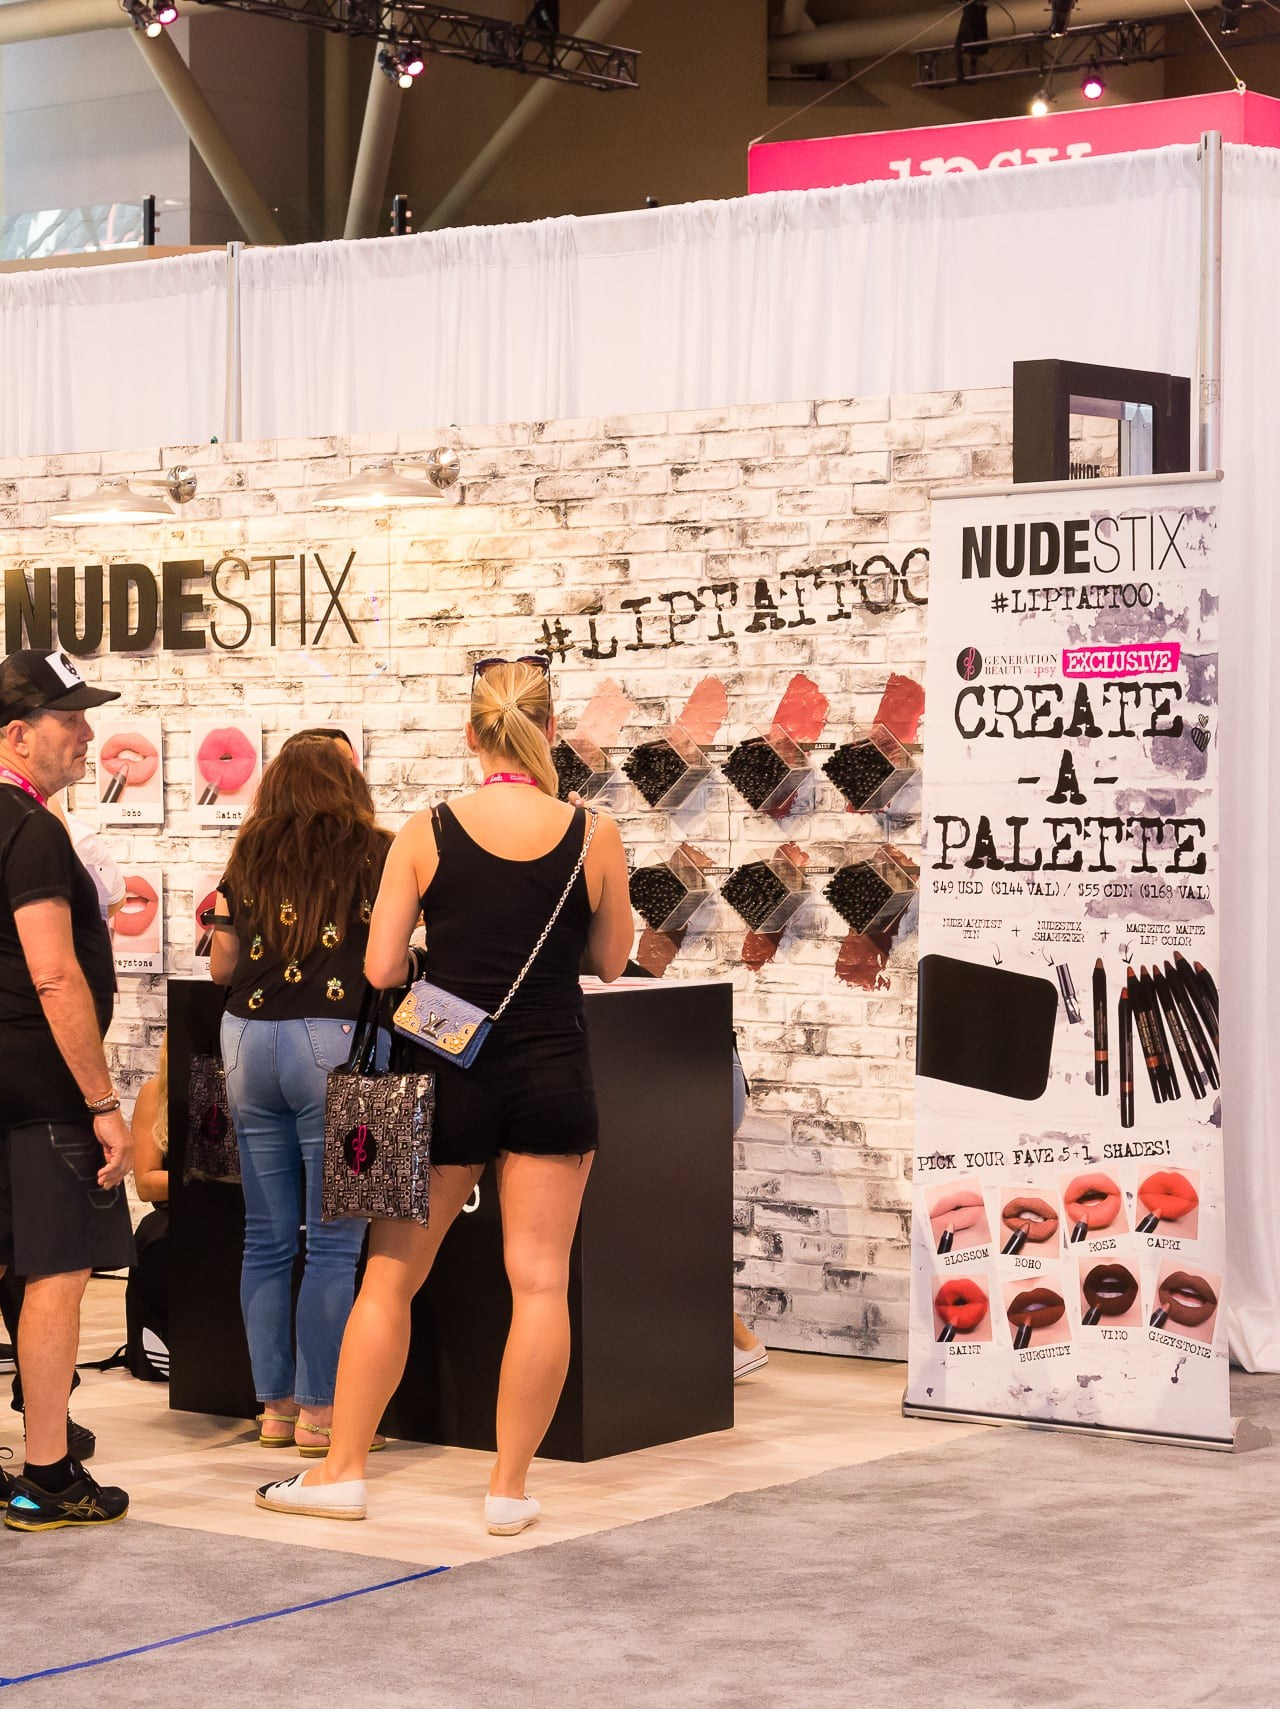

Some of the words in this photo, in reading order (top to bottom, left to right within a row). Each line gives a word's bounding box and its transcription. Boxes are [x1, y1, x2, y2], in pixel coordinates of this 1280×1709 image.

[961, 513, 1187, 580] NUDESTIX
[4, 551, 360, 656] NUDESTIX
[991, 583, 1153, 614] #LIPTATTOO
[984, 654, 1057, 665] GENERATION
[1066, 650, 1172, 673] EXCLUSIVE
[985, 666, 1023, 675] BEAUTY
[1033, 666, 1057, 677] ipsy
[954, 681, 1184, 739] CREATE
[122, 809, 142, 817] Boho
[216, 811, 242, 819] Saint
[931, 815, 1207, 875] PALETTE
[933, 880, 954, 894] $49
[958, 881, 984, 895] USD
[991, 881, 1023, 896] ($144
[1026, 882, 1060, 897] VAL)
[1078, 883, 1100, 897] $55
[1103, 884, 1133, 898] CDN
[1140, 884, 1173, 899] ($168
[1178, 885, 1210, 900] VAL)
[1126, 924, 1170, 935] MAGNETIC
[1176, 925, 1206, 935] MATTE
[1140, 935, 1158, 945] LIP
[1161, 936, 1192, 946] COLOR
[114, 957, 153, 969] eystone
[917, 1153, 957, 1171] PICK
[964, 1152, 1004, 1168] YOUR
[1013, 1148, 1054, 1165] FAVE
[1103, 1139, 1172, 1159] SHADES!
[1089, 1238, 1117, 1253] ROSE
[1147, 1237, 1181, 1251] CAPRI
[943, 1248, 989, 1266] BLOSSOM
[1014, 1258, 1042, 1270] BOHO
[1101, 1329, 1128, 1341] VINO
[949, 1344, 982, 1356] SAINT
[1148, 1331, 1212, 1359] GREYSTONE
[1019, 1345, 1071, 1363] BURGUNDY
